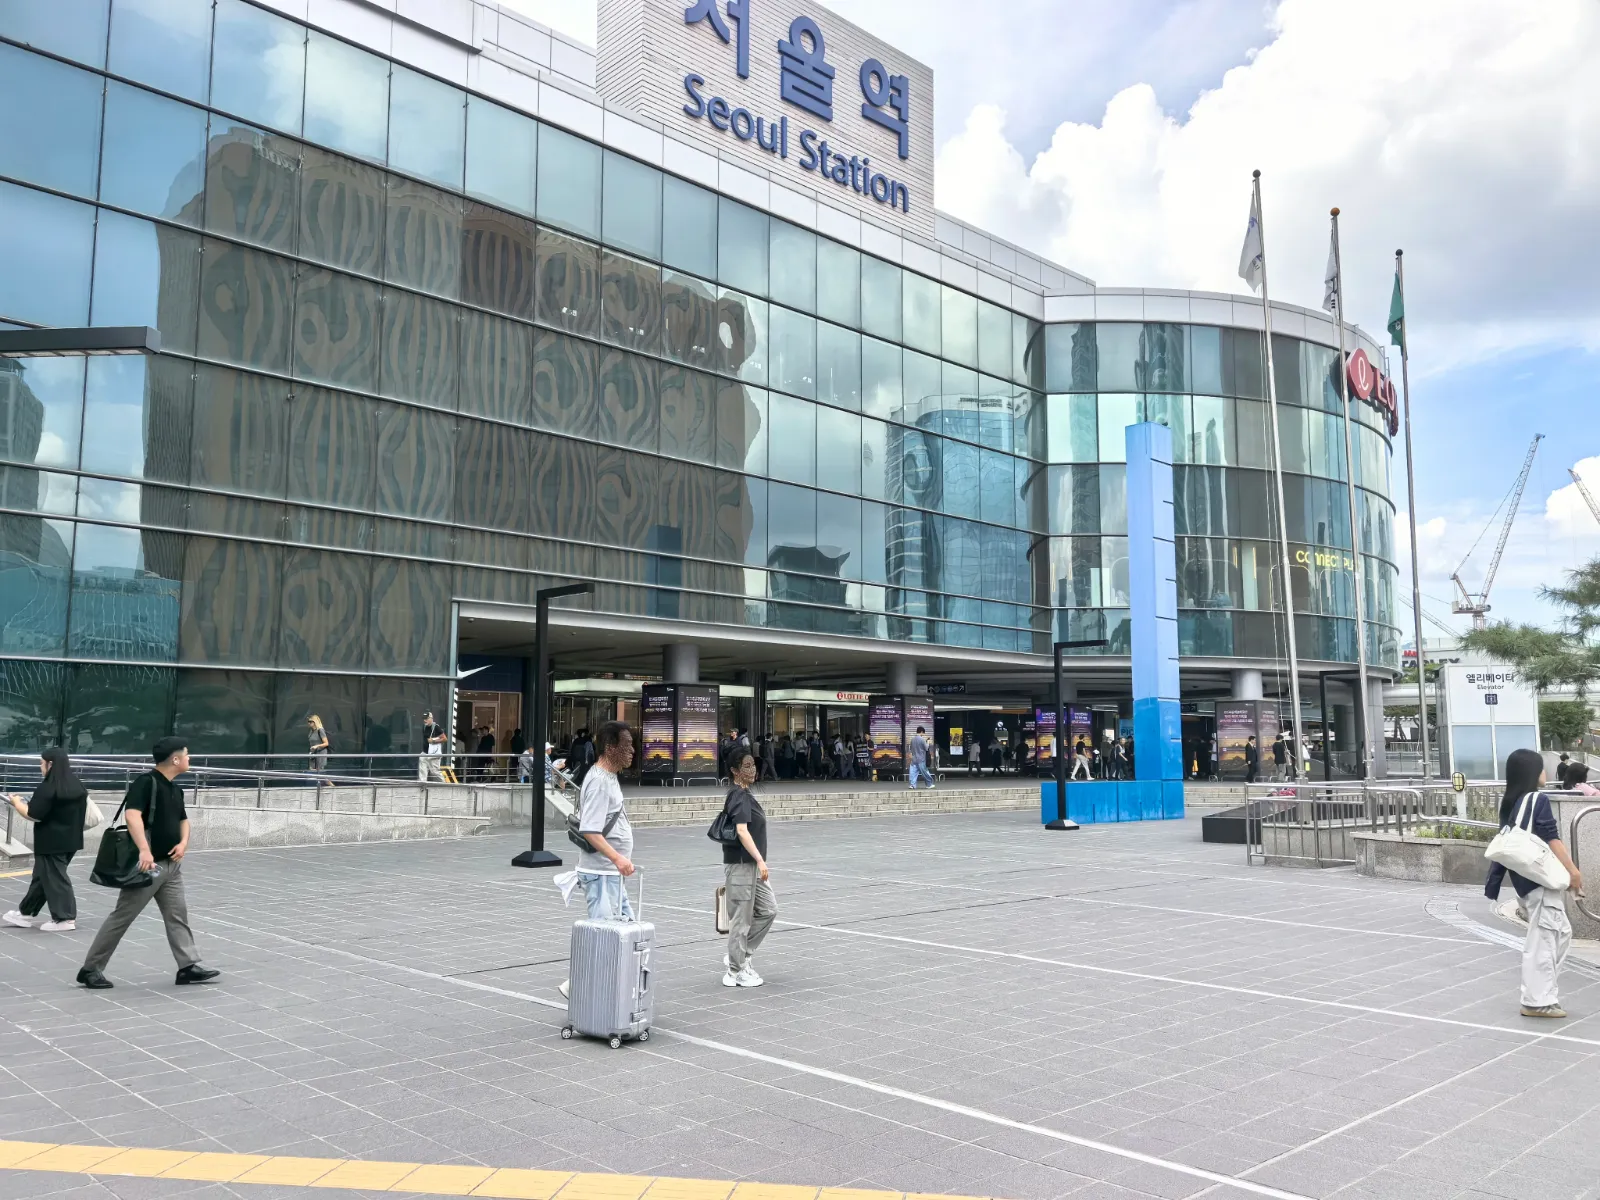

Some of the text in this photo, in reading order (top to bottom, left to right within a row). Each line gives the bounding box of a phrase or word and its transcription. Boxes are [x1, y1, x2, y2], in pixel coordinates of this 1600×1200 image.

[683, 73, 910, 213] Seoul Station
[685, 0, 909, 160] 서울역
[1465, 673, 1515, 684] 엘리베이터
